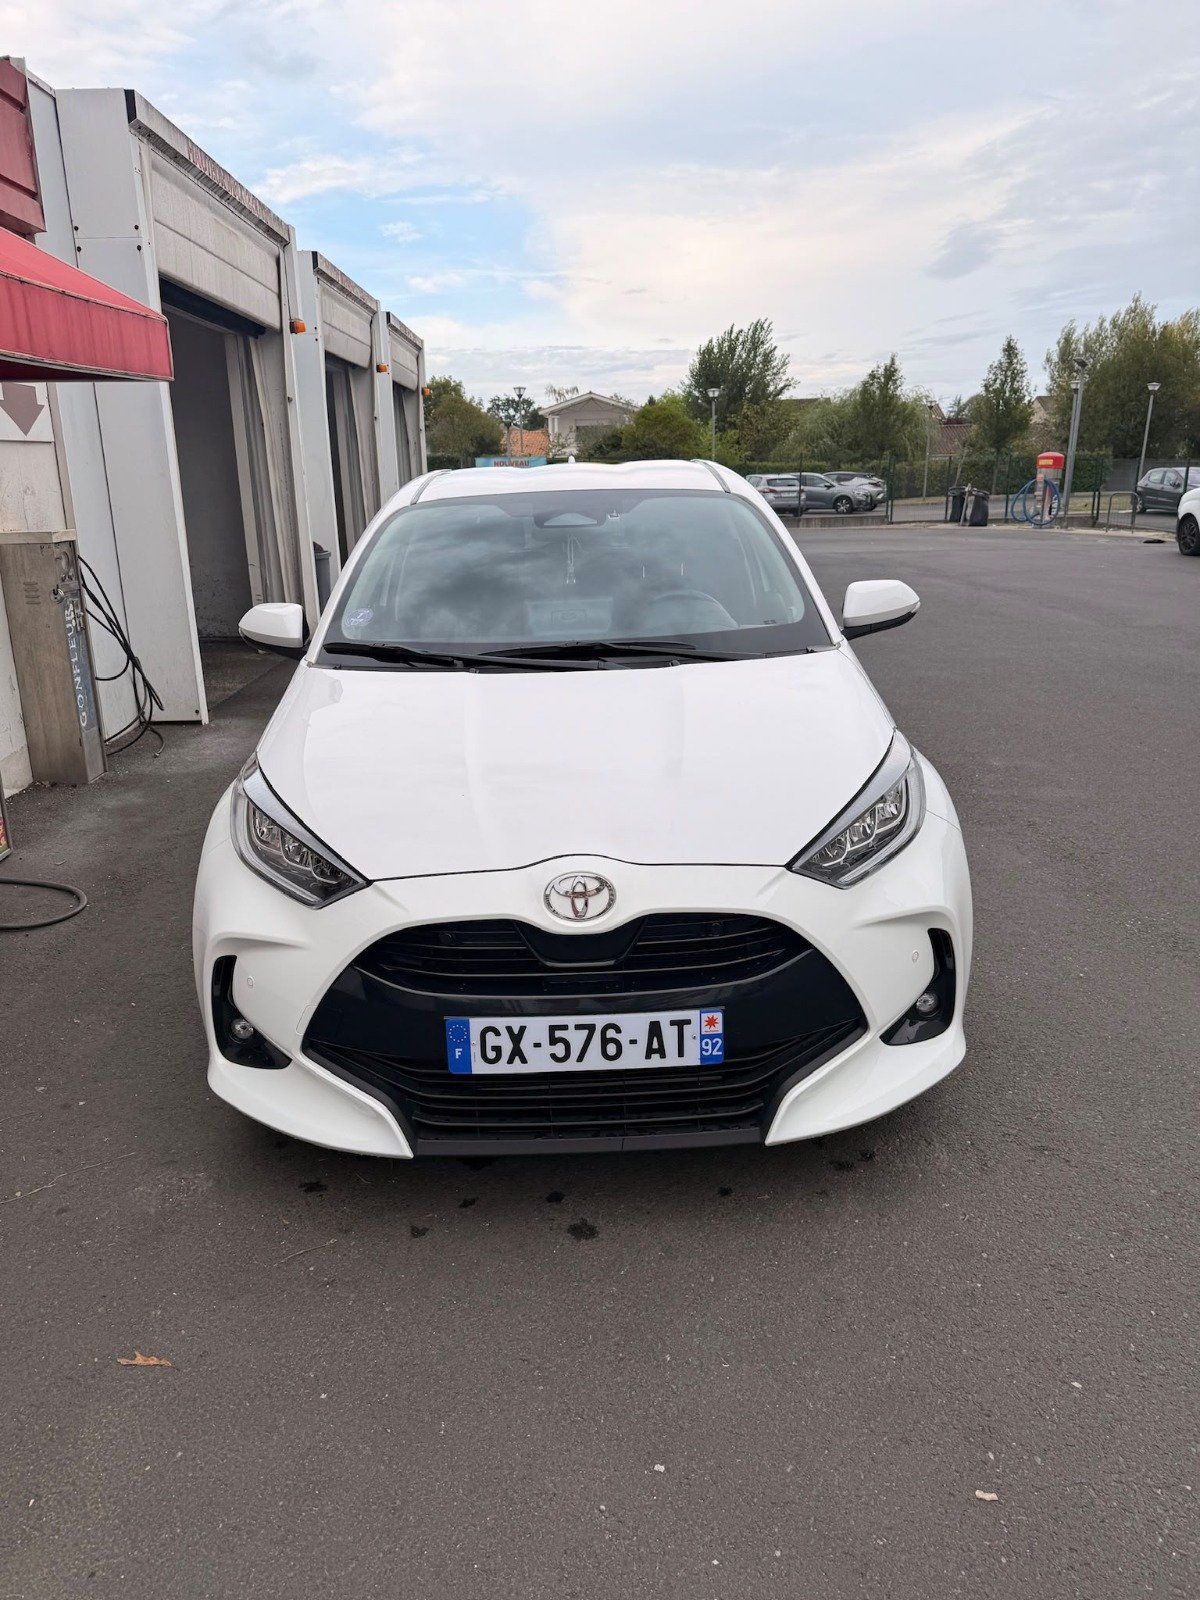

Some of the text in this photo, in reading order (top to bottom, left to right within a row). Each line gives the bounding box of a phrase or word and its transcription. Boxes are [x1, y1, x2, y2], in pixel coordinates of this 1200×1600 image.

[64, 603, 88, 727] GONFLEUR
[454, 1047, 463, 1059] F
[480, 1018, 692, 1065] GX-576-AT
[701, 1037, 723, 1056] 92
